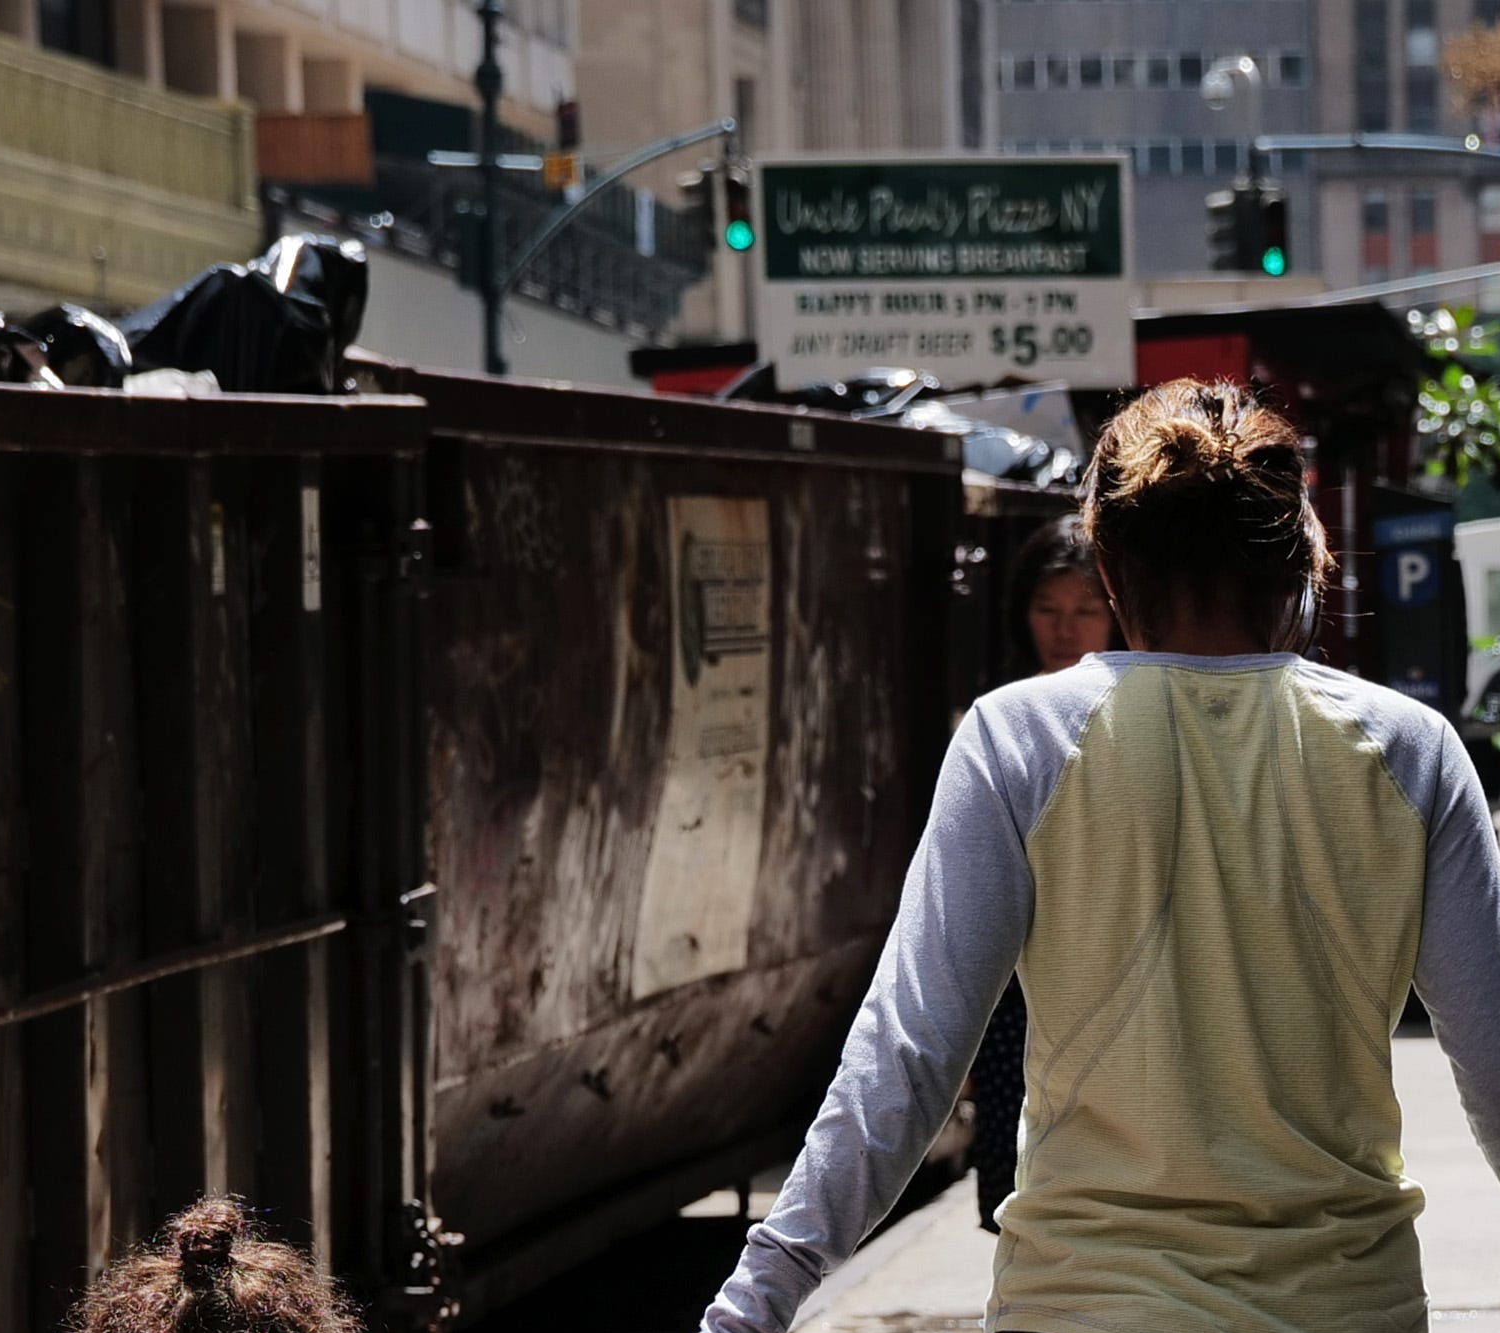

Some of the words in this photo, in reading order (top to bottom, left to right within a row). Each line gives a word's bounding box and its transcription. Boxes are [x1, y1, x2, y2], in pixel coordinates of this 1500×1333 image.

[776, 186, 862, 235] Uncle
[967, 185, 1058, 234] Pizza
[1060, 178, 1106, 233] NY
[801, 243, 852, 274] NOW
[857, 243, 952, 274] SERVING
[955, 242, 1088, 273] BREAKFAST
[796, 292, 871, 315] HAPPY
[881, 292, 946, 314] HOUR
[973, 293, 1006, 314] PM
[1044, 292, 1077, 314] PM
[792, 330, 834, 355] ANY
[840, 330, 911, 356] DRAFT
[917, 330, 973, 357] BEER
[990, 324, 1093, 366] $5.00
[1397, 550, 1431, 602] P
